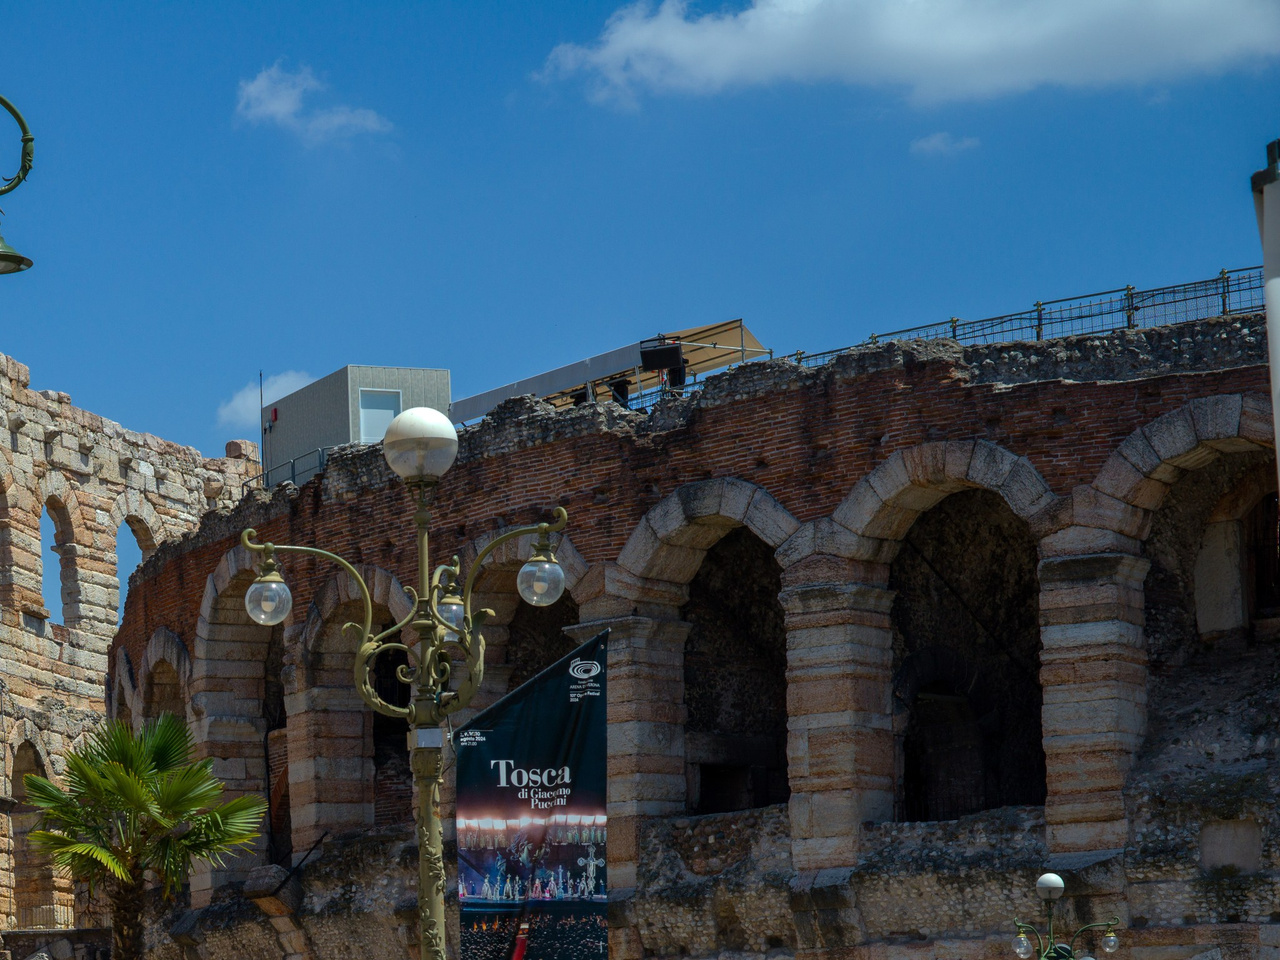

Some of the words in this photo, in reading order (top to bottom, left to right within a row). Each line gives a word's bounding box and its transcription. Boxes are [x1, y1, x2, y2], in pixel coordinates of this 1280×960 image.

[490, 760, 572, 787] Tosca
[518, 788, 528, 799] di
[530, 787, 571, 799] Giacomo
[530, 795, 567, 809] Puccini
